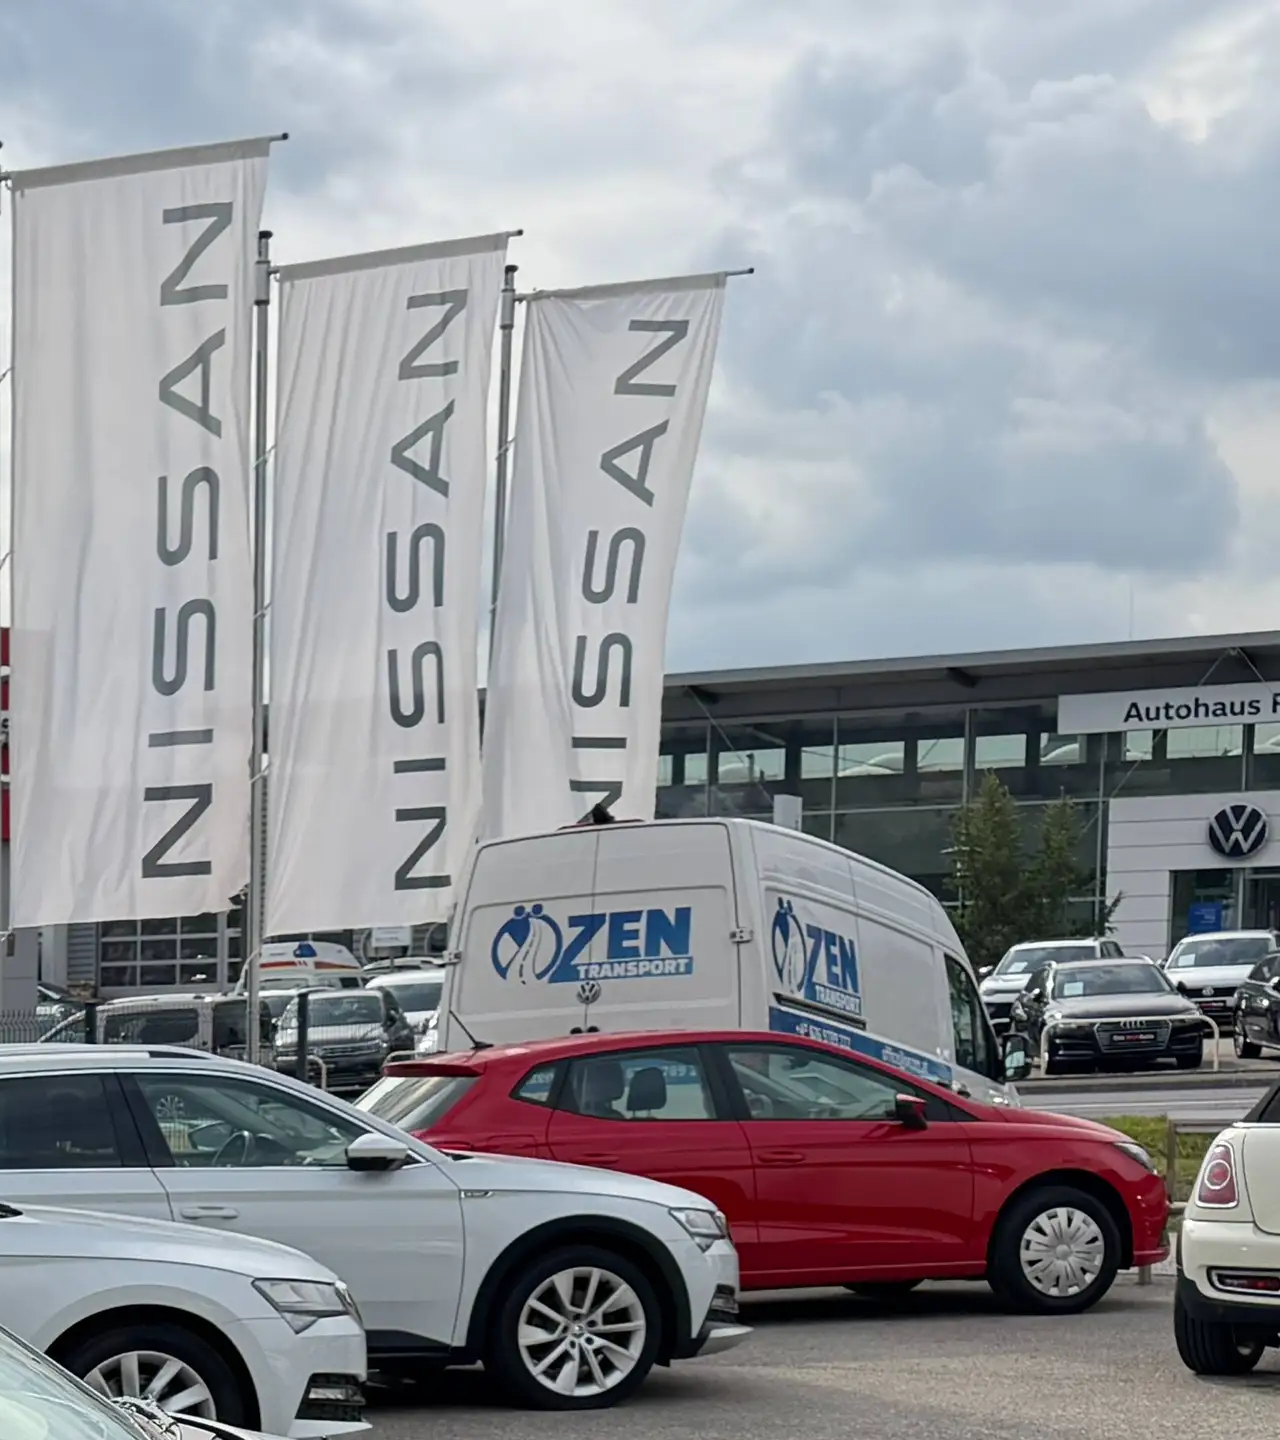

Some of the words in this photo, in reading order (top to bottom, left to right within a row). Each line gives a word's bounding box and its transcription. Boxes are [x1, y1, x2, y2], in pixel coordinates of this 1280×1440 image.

[141, 201, 234, 879] NISSAN
[386, 288, 469, 891] NISSAN
[1123, 697, 1261, 723] Autohaus
[577, 959, 690, 980] TRANSPORT
